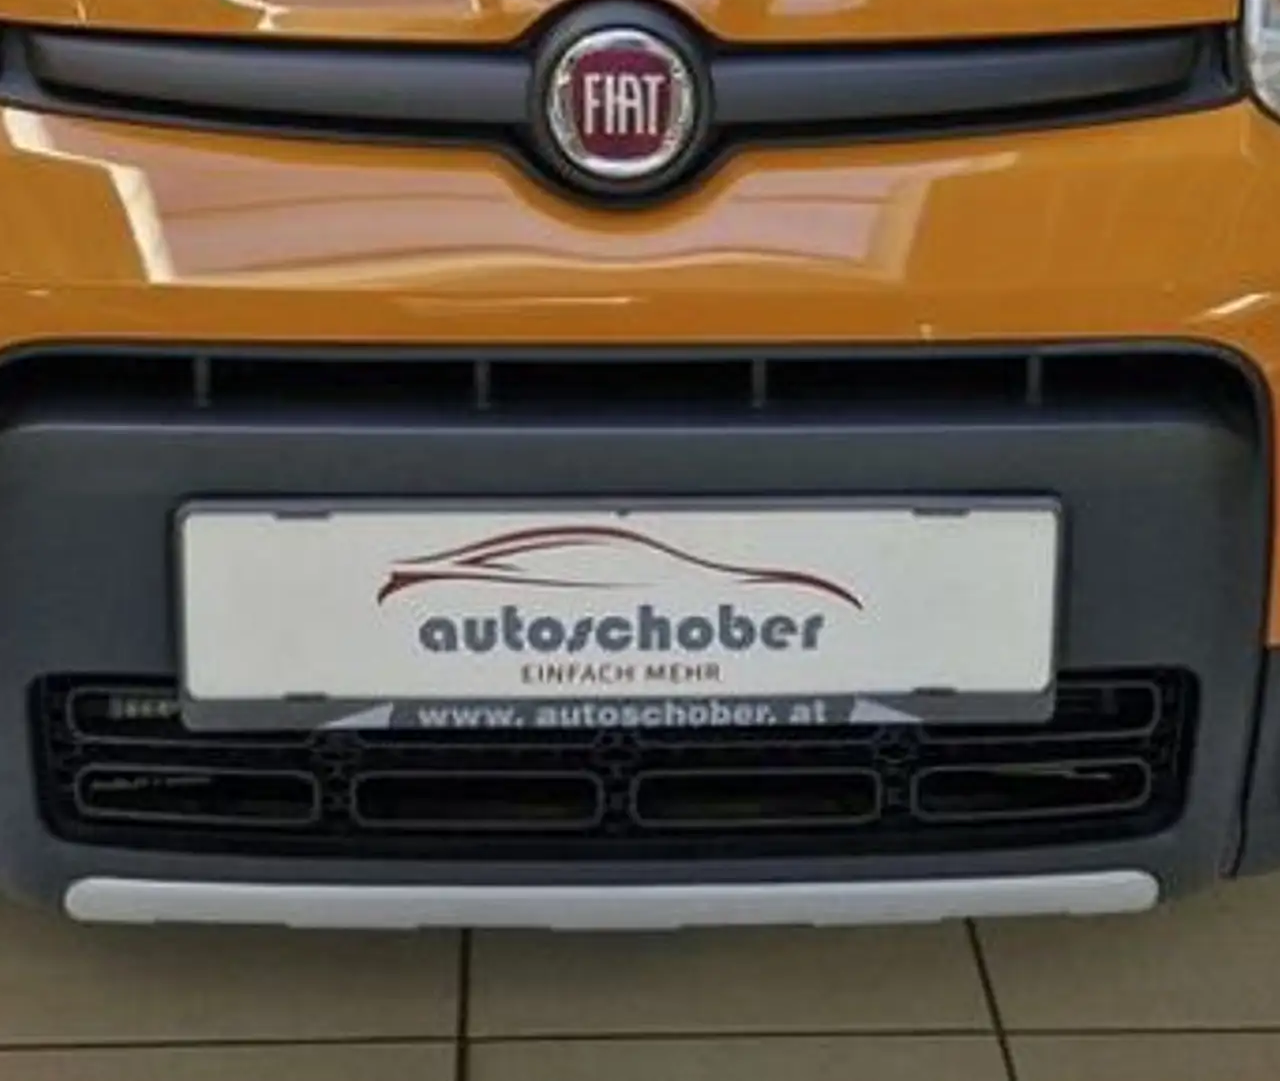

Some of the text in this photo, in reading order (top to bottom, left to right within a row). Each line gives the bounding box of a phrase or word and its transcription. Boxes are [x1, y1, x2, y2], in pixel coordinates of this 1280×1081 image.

[582, 71, 666, 136] FIAT
[419, 604, 824, 653] autoschober
[521, 661, 724, 684] EINFACH MEHR
